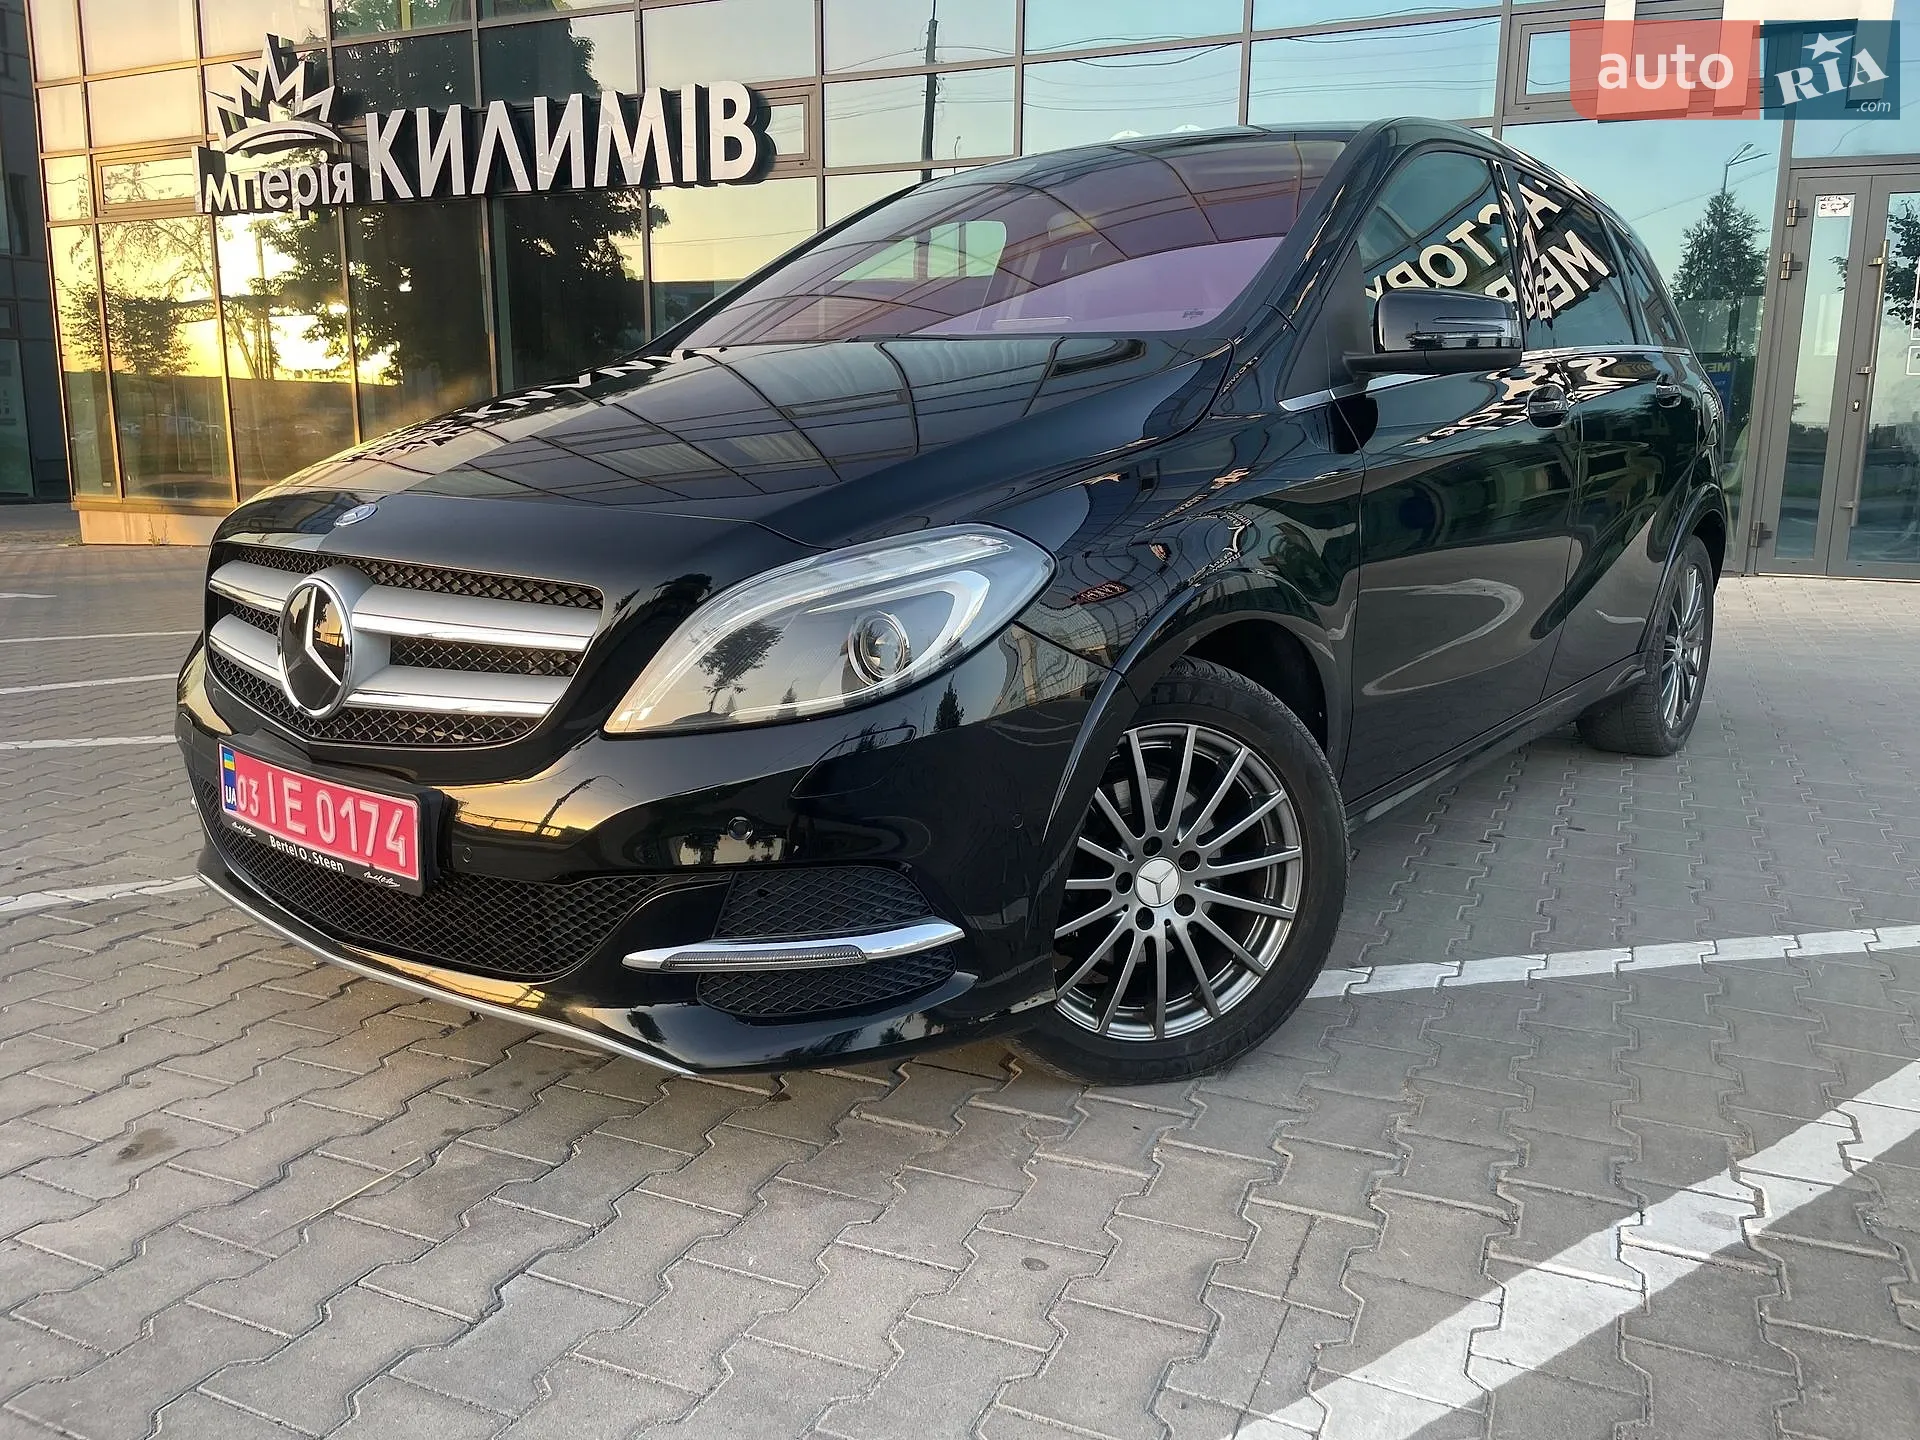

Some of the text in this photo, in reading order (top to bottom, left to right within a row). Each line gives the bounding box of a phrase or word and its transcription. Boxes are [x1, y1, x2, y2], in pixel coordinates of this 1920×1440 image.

[367, 81, 757, 201] КИЛИМІВ
[225, 785, 237, 806] UA
[237, 771, 406, 867] 03 IE 0174
[269, 834, 345, 873] Bertel O. Steen
